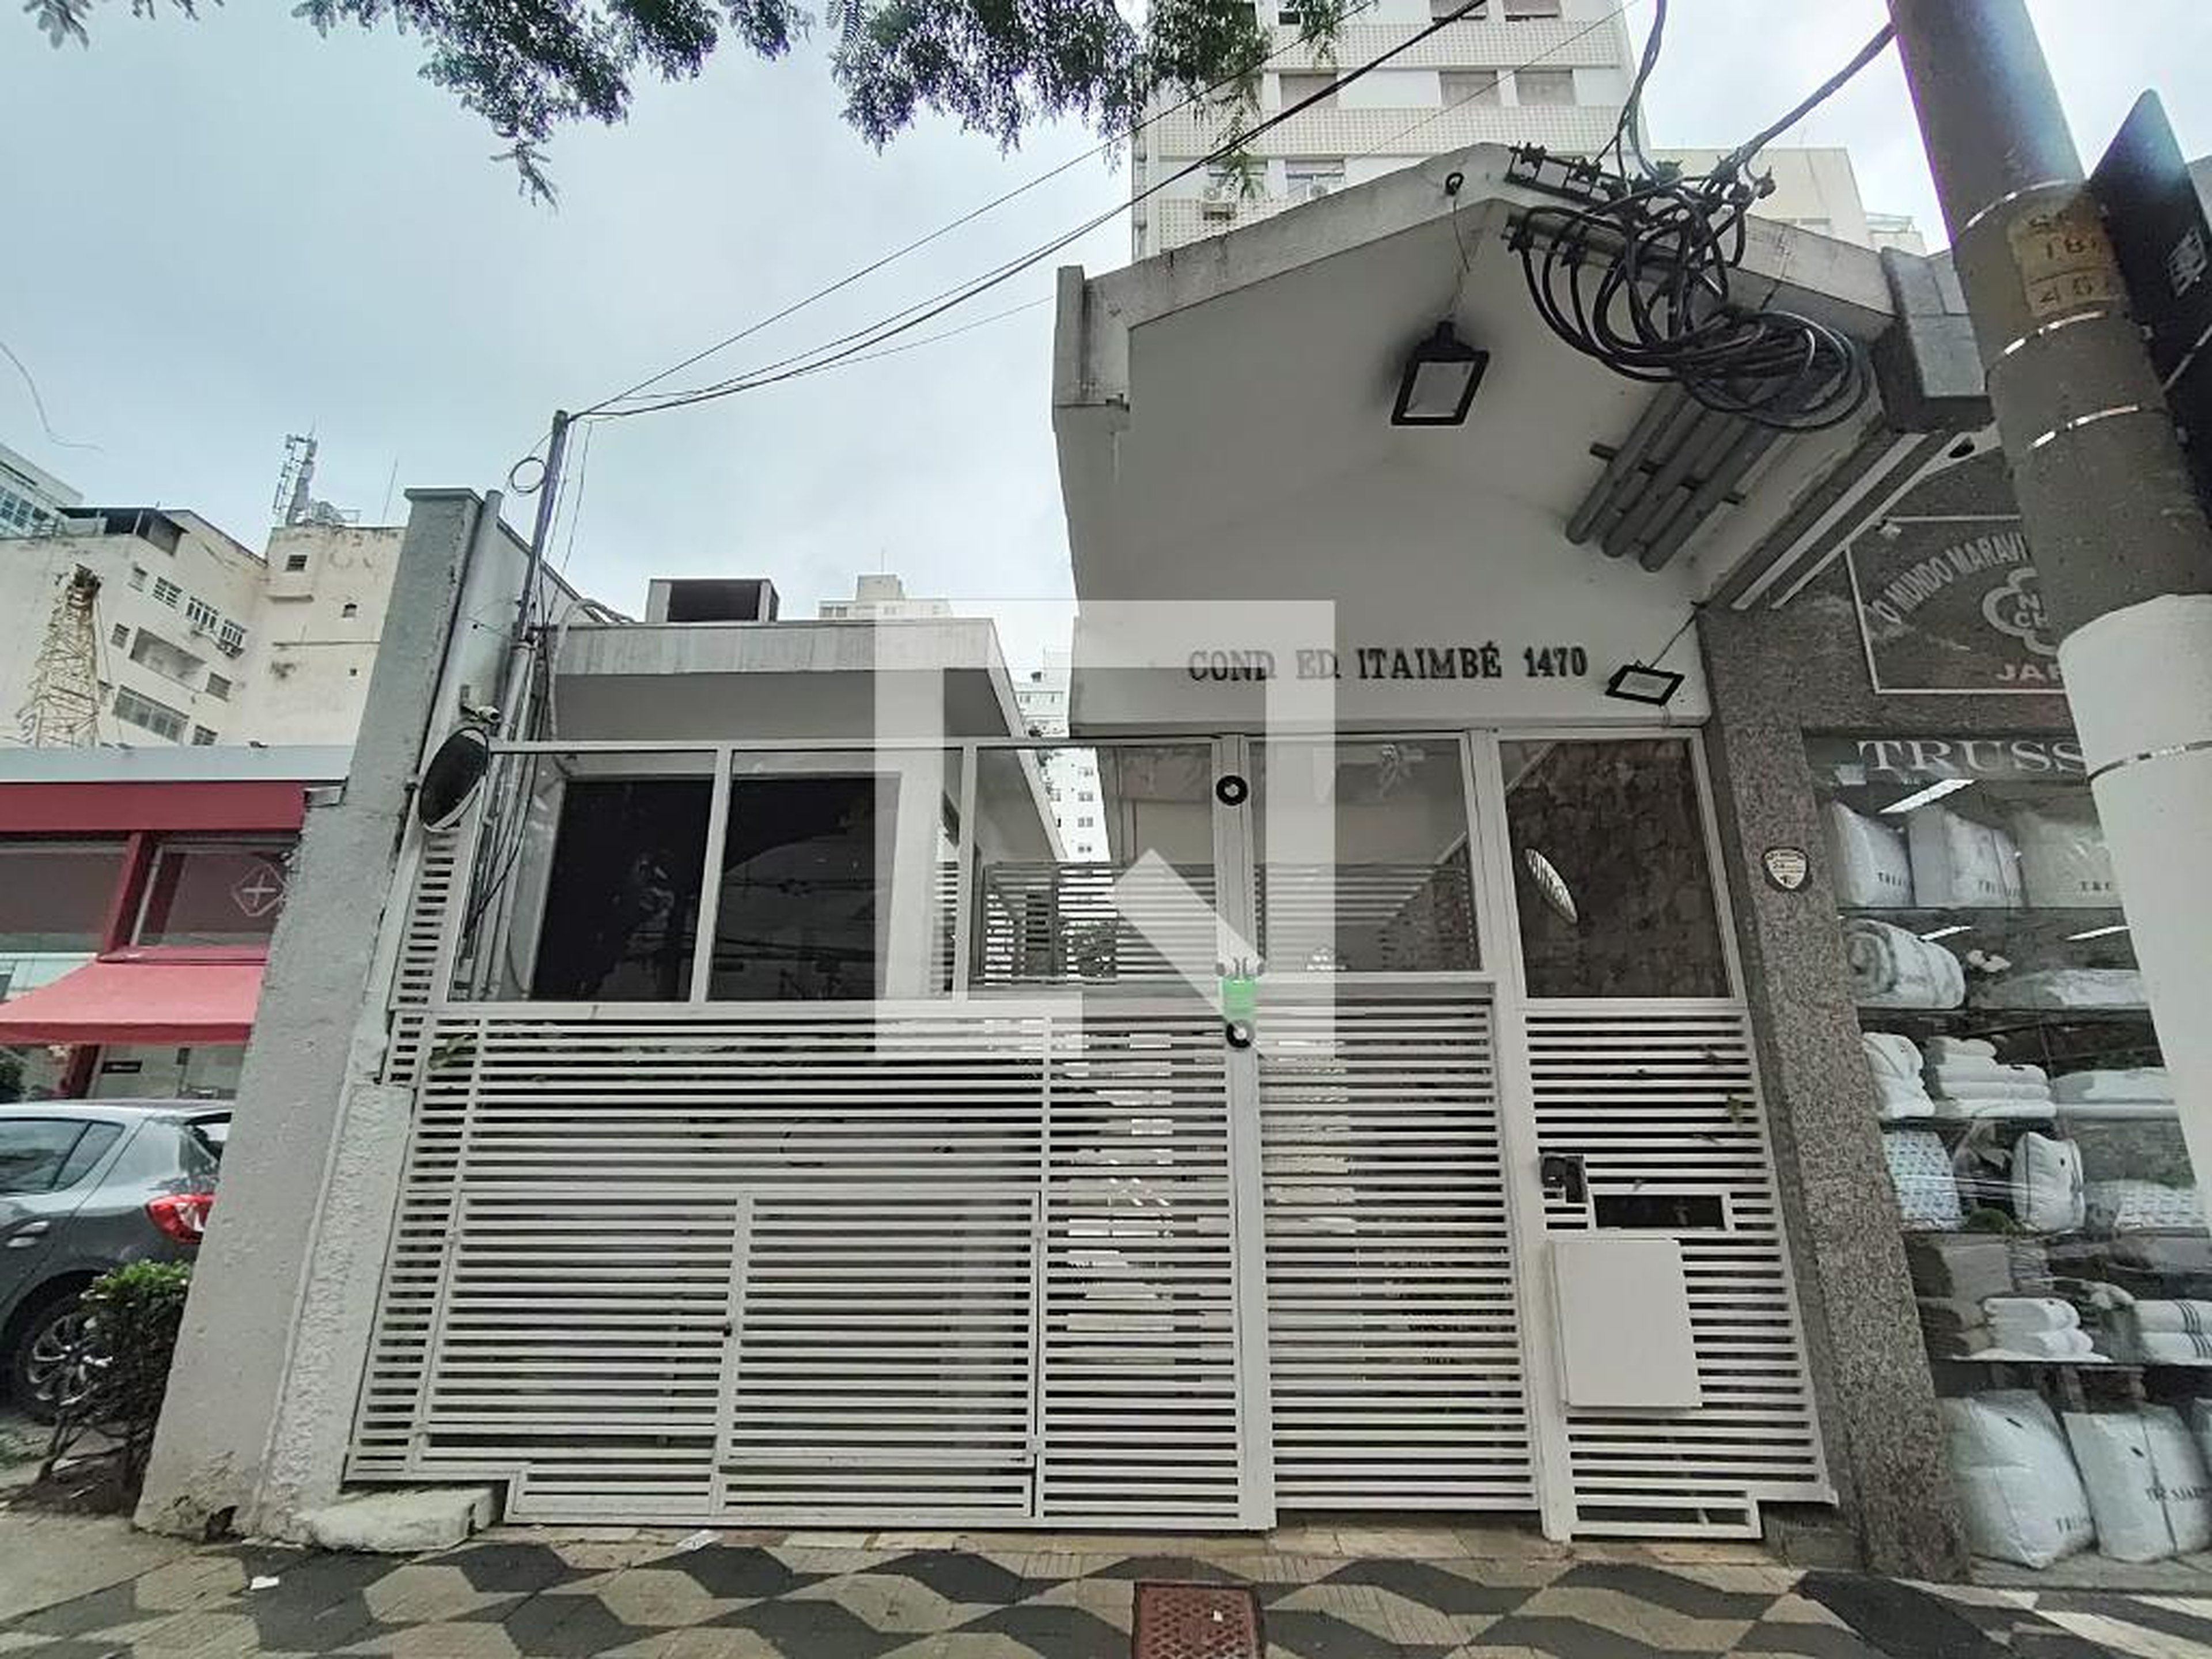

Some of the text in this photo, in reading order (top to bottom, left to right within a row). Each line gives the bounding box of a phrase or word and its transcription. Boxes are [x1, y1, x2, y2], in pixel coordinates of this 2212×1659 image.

[1884, 556, 1953, 613] MUNDO
[1872, 599, 1902, 624] O
[1188, 649, 1277, 681] COND
[1357, 641, 1502, 680] ITAIMBÉ
[1524, 646, 1588, 677] 1470
[1857, 740, 2087, 773] TRUSS
